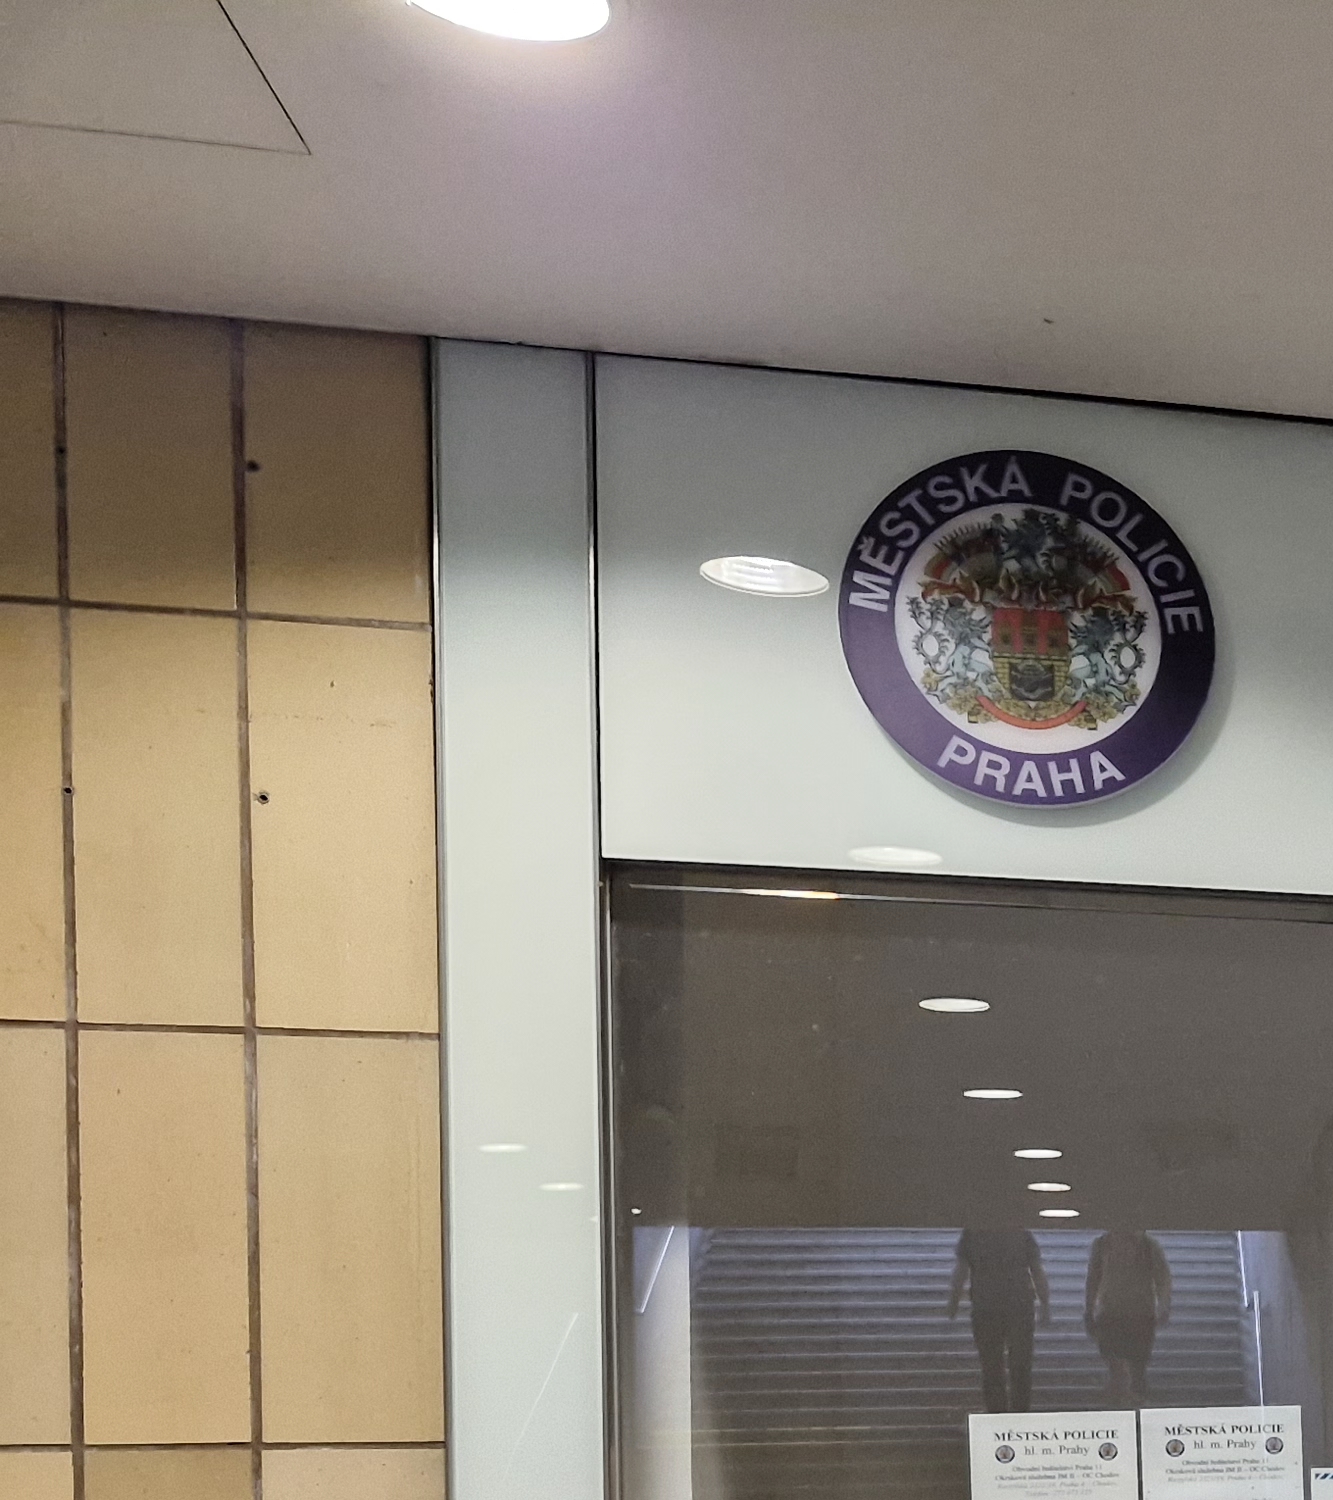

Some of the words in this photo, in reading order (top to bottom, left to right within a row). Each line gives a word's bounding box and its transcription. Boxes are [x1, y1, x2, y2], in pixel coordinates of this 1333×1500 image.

[849, 455, 1035, 612] MĚSTSKÁ
[1060, 472, 1204, 634] POLICIE
[936, 735, 1126, 798] PRAHA
[994, 1428, 1059, 1441] MĚSTSKÁ
[1064, 1430, 1118, 1440] POLICIE
[1165, 1424, 1226, 1436] MĚSTSKÁ
[1232, 1424, 1284, 1434] POLICIE
[1059, 1445, 1090, 1456] Prahy
[1227, 1440, 1256, 1450] Prahy
